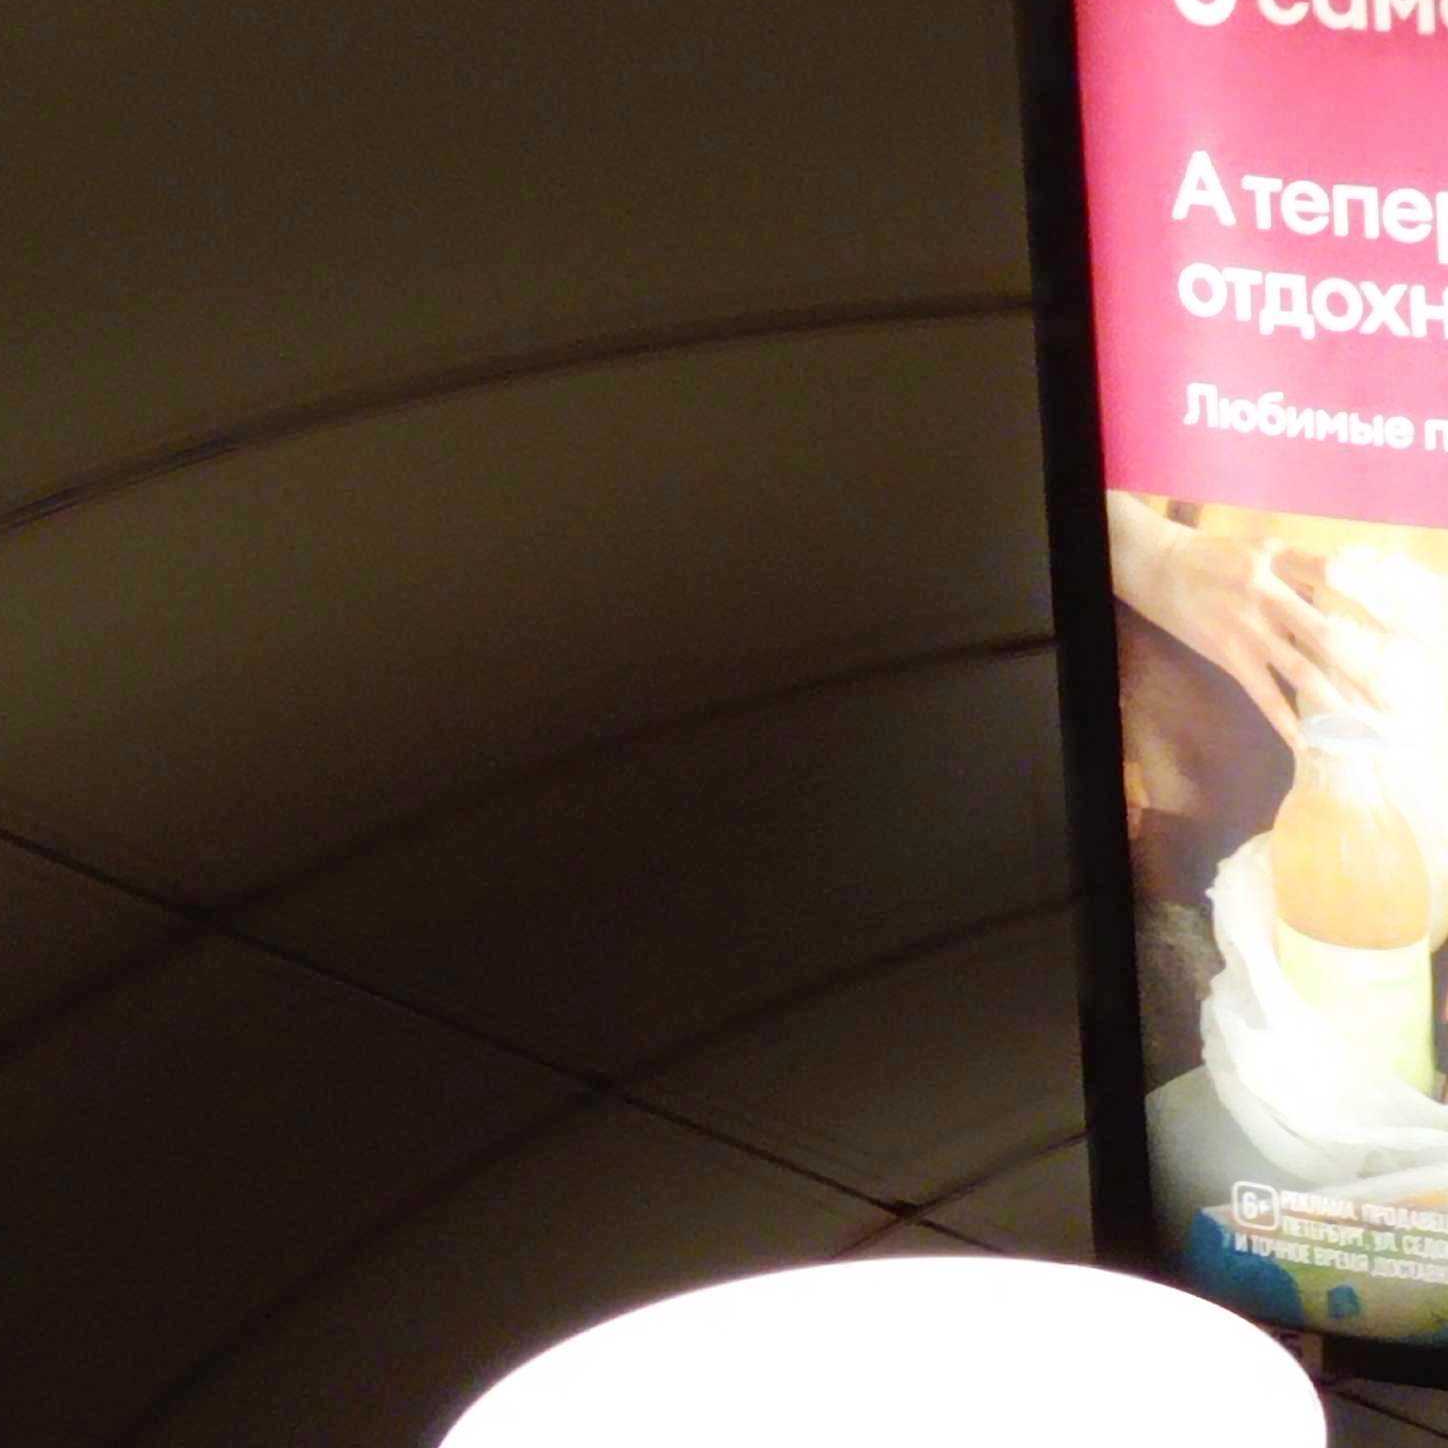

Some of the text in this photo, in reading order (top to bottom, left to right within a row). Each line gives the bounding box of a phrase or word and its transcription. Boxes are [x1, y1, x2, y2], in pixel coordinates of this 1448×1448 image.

[1172, 151, 1234, 224] А
[1184, 383, 1414, 456] Любимые
[1241, 1191, 1272, 1220] 6+
